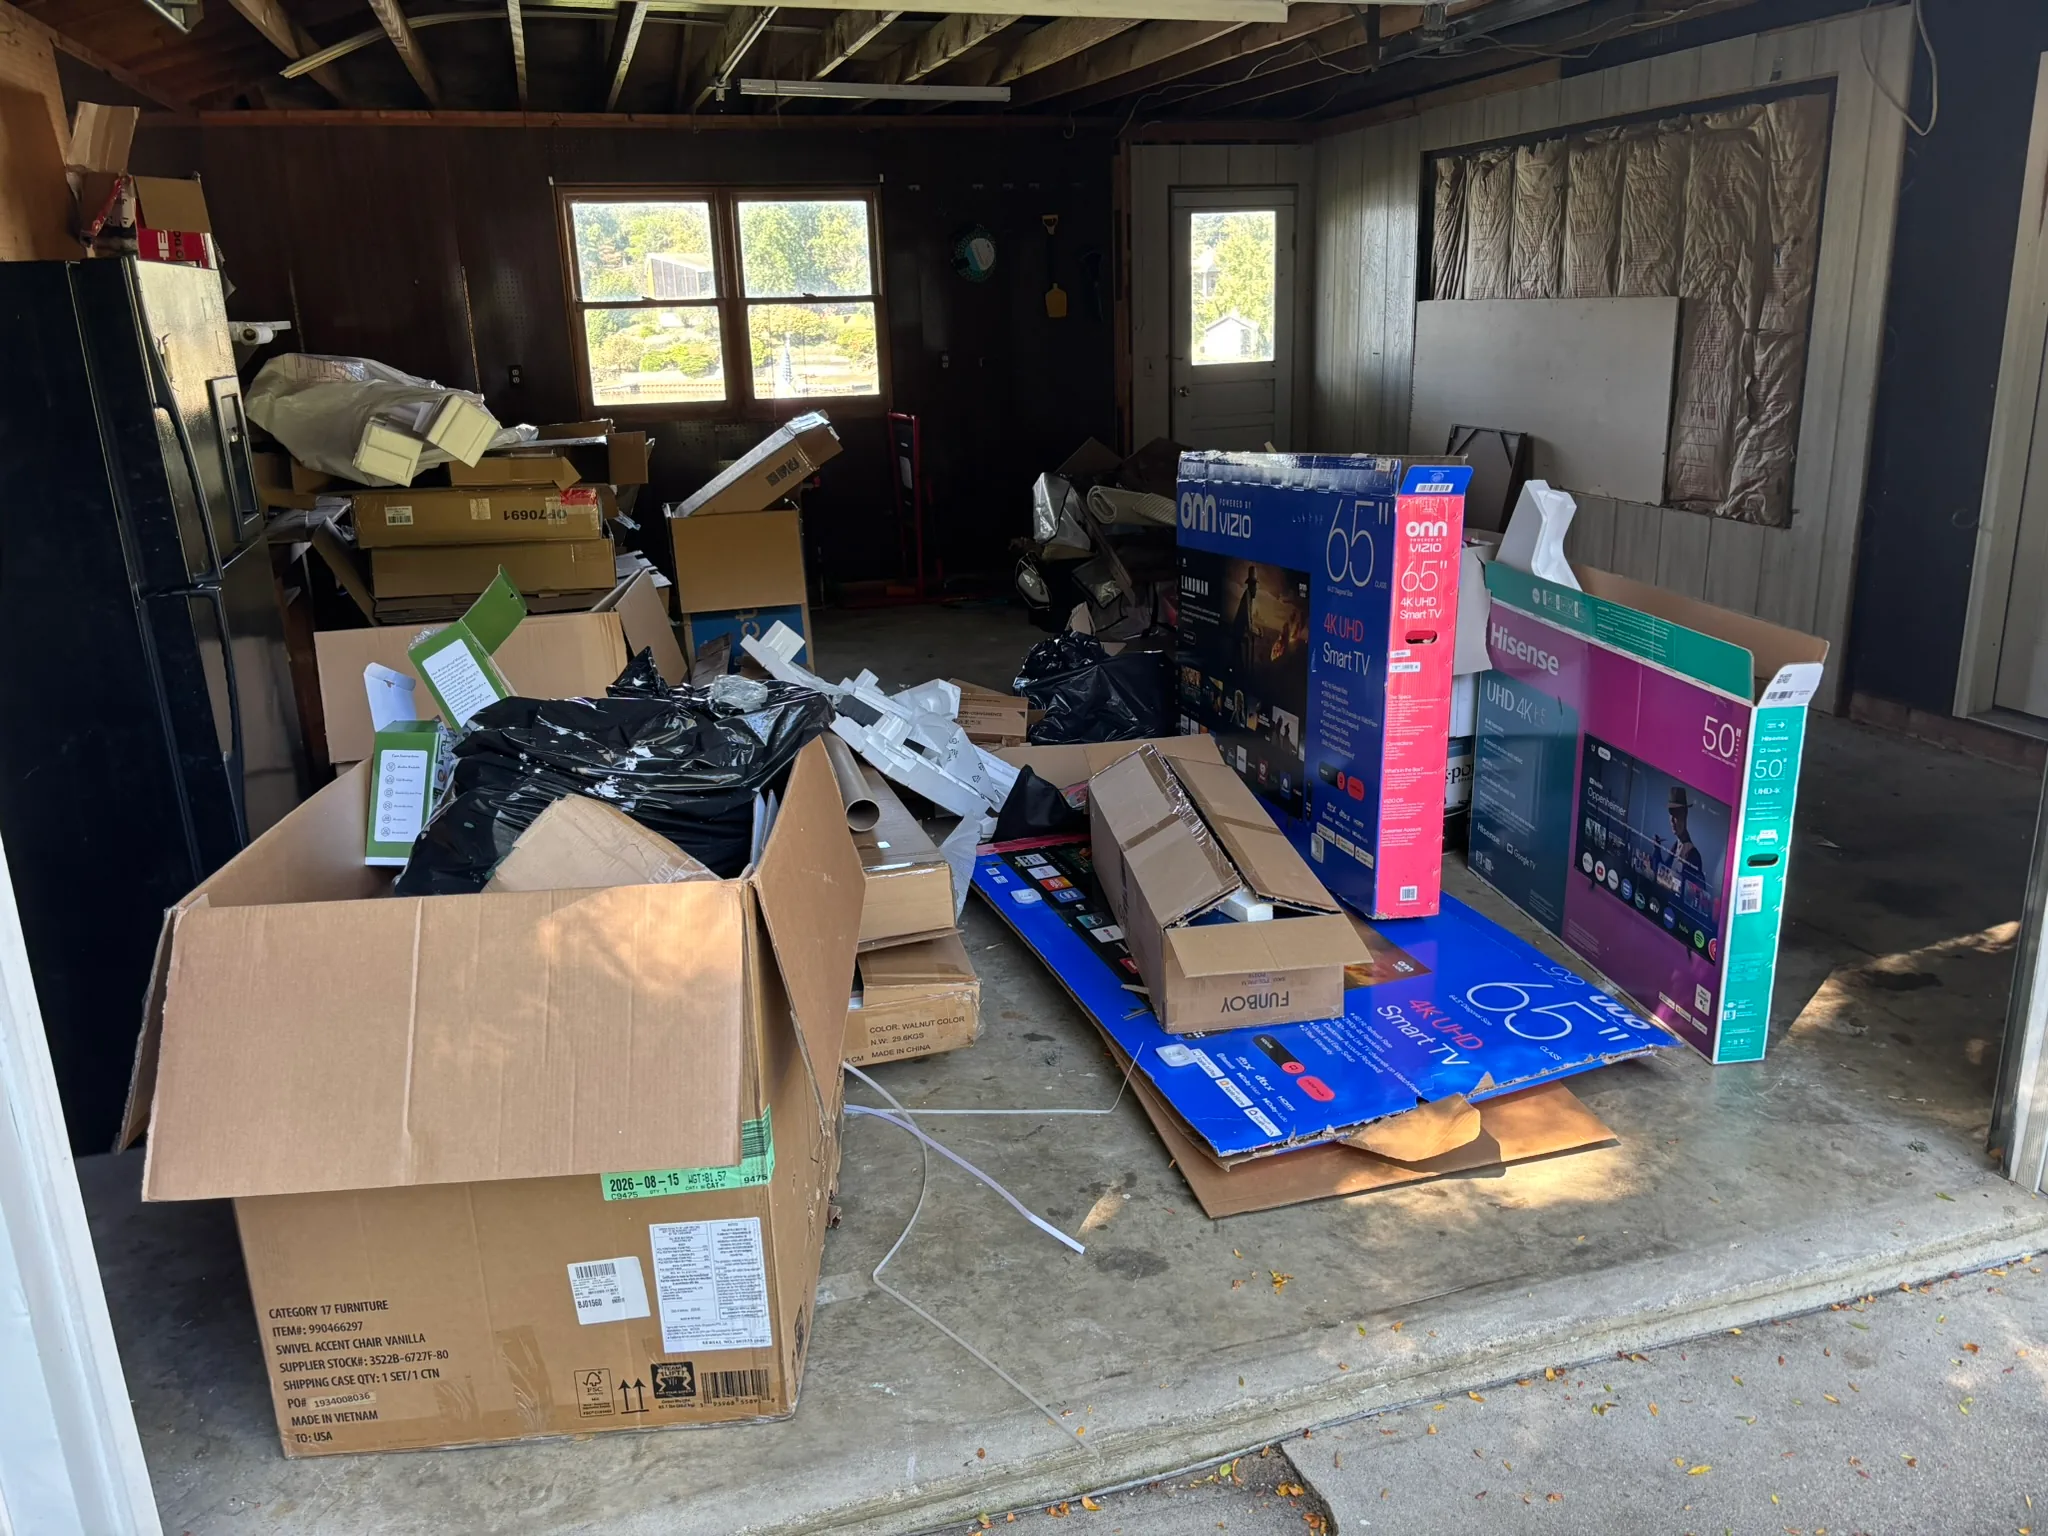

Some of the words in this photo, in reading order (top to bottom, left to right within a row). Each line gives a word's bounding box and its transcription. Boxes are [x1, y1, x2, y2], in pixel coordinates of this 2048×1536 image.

[1180, 492, 1217, 533] onn
[1219, 498, 1243, 509] POWERED
[1245, 501, 1252, 510] BY
[1219, 512, 1252, 539] VIZIO
[1405, 520, 1447, 537] onn
[1326, 498, 1389, 588] 65"
[1410, 543, 1442, 553] VIZIO
[1400, 560, 1447, 593] 65"
[1400, 597, 1414, 607] 4K
[1414, 597, 1437, 607] UHD
[1400, 609, 1427, 620] Smart
[1428, 609, 1442, 618] TV
[1324, 613, 1337, 636] 4K
[1339, 619, 1364, 643] UHD
[1323, 641, 1351, 671] Smart
[1353, 651, 1371, 676] TV
[1490, 622, 1559, 676] Hisense
[1487, 680, 1515, 711] UHD
[1516, 697, 1533, 724] 4K
[1588, 787, 1626, 817] Oppenheimer
[1477, 822, 1501, 846] Hisense
[1513, 849, 1531, 867] Google
[1466, 982, 1630, 1042] 65"
[870, 1023, 900, 1034] COLOR:
[902, 1020, 935, 1030] WALNUT
[936, 1016, 965, 1026] COLOR
[1377, 1005, 1436, 1046] Smart
[1428, 1042, 1470, 1064] TV
[1409, 1000, 1444, 1019] 4K
[1432, 1017, 1484, 1050] UHD
[872, 1047, 894, 1058] MADE
[906, 1044, 932, 1053] CHINA
[1540, 1045, 1562, 1061] CLASS
[744, 1174, 768, 1184] 9475
[269, 1306, 318, 1319] CATEGORY
[321, 1305, 332, 1315] 17
[335, 1300, 389, 1314] FURNITURE
[272, 1326, 307, 1338] ITEM#:
[309, 1321, 363, 1334] 990466297
[276, 1343, 313, 1356] SWIVEL
[316, 1340, 350, 1352] ACCENT
[352, 1337, 382, 1349] CHAIR
[385, 1333, 426, 1346] VANILLA
[280, 1360, 326, 1373] SUPPLIER
[327, 1356, 368, 1370] STOCK#:
[370, 1350, 449, 1366] 3522B-6727F-80
[284, 1378, 330, 1391] SHIPPING
[331, 1375, 356, 1386] CASE
[358, 1373, 380, 1385] QTY:
[382, 1372, 388, 1382] 1
[420, 1368, 440, 1379] CTN
[287, 1398, 307, 1408] PO#
[314, 1392, 371, 1408] 1934008036
[292, 1414, 320, 1426] MADE
[322, 1414, 332, 1424] IN
[334, 1410, 379, 1422] VIETNAM
[296, 1434, 312, 1443] TO:
[314, 1431, 333, 1442] USA
